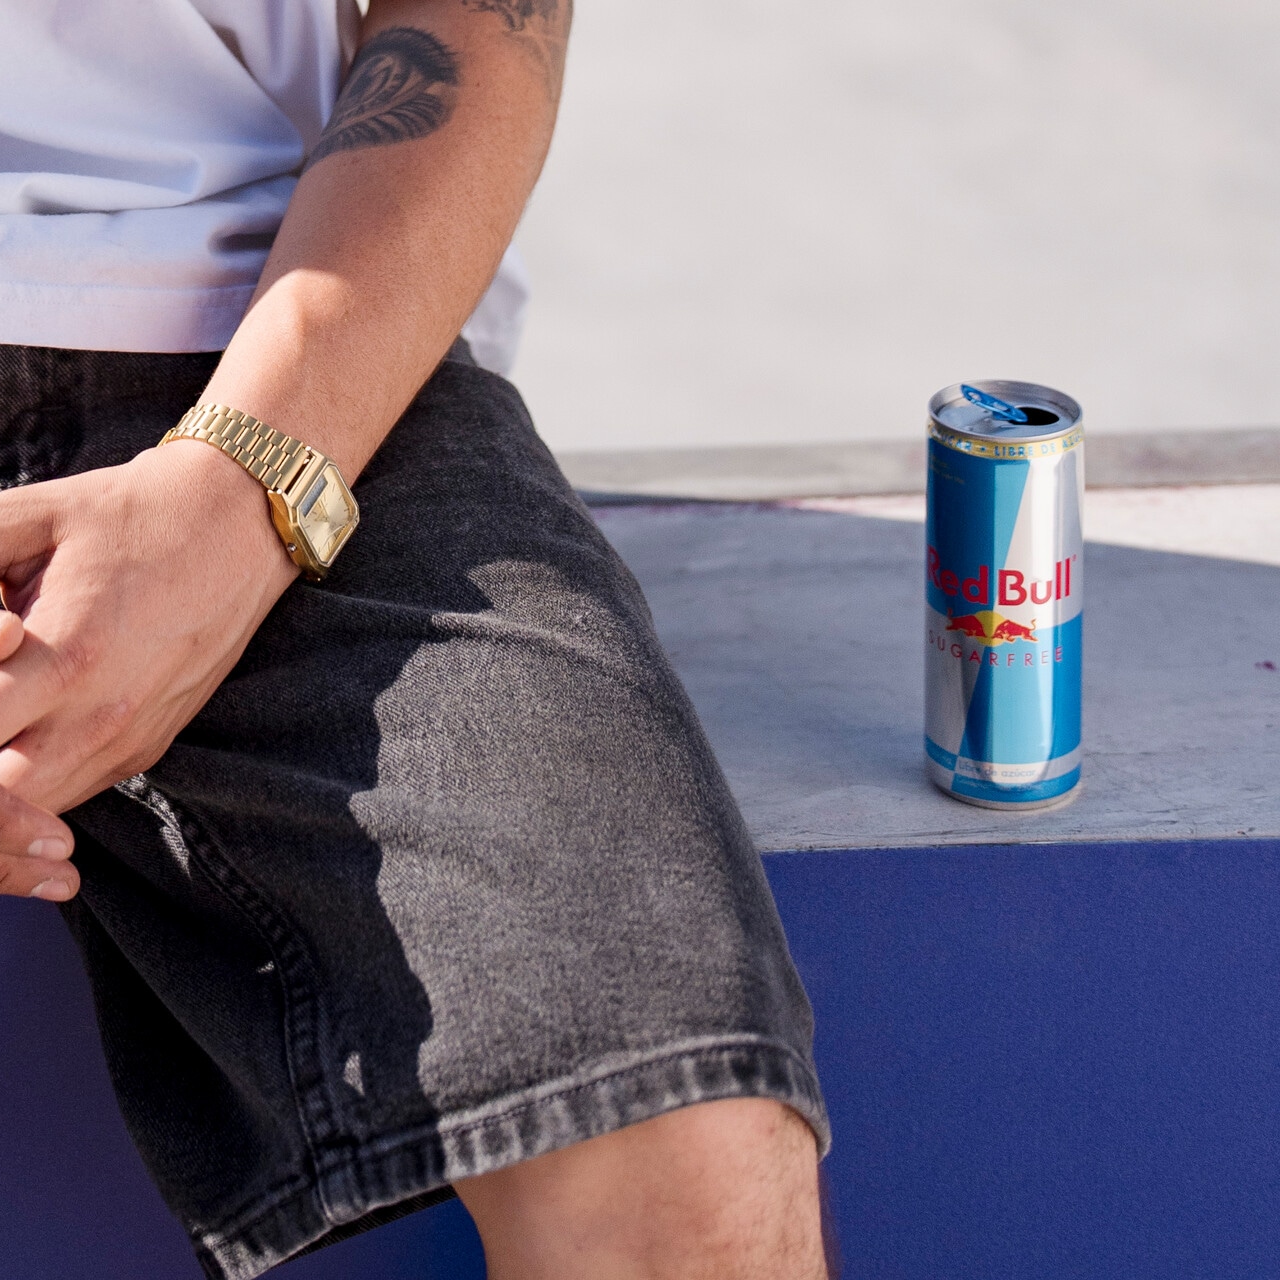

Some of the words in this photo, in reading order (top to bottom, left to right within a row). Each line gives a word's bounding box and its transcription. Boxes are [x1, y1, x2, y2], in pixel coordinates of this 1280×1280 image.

[994, 445, 1034, 457] LIBRE
[1041, 443, 1057, 454] DE
[926, 543, 989, 605] Red
[997, 557, 1071, 606] Bull
[927, 629, 1063, 667] SUGARFREE
